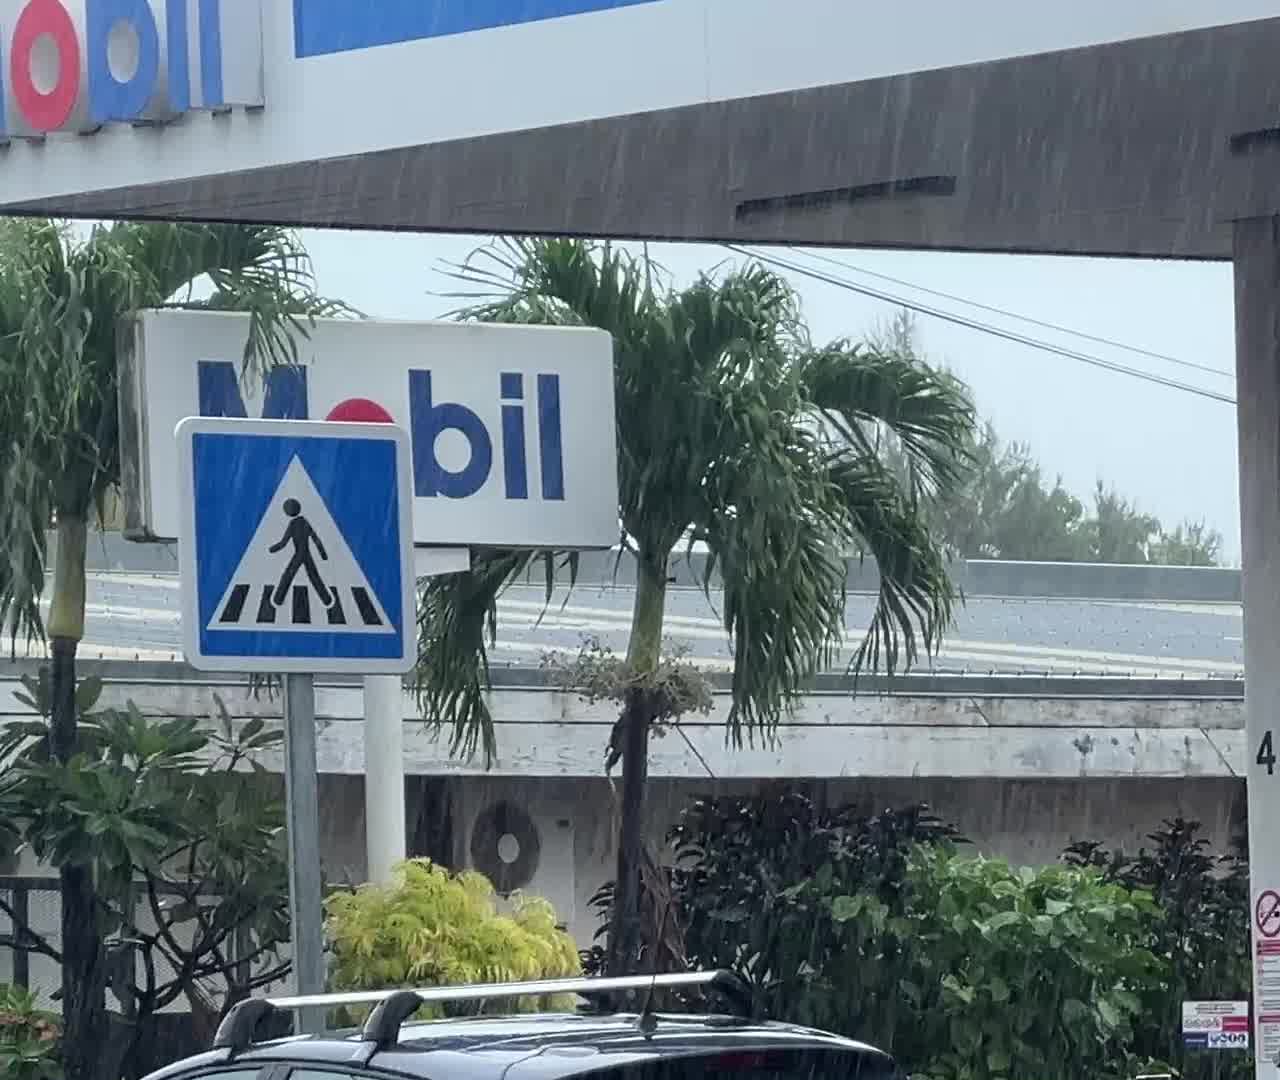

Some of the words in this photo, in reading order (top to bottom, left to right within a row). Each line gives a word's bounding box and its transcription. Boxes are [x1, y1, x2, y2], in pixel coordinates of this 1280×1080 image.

[0, 0, 224, 137] obil
[198, 360, 565, 501] bil
[1256, 731, 1276, 775] 4
